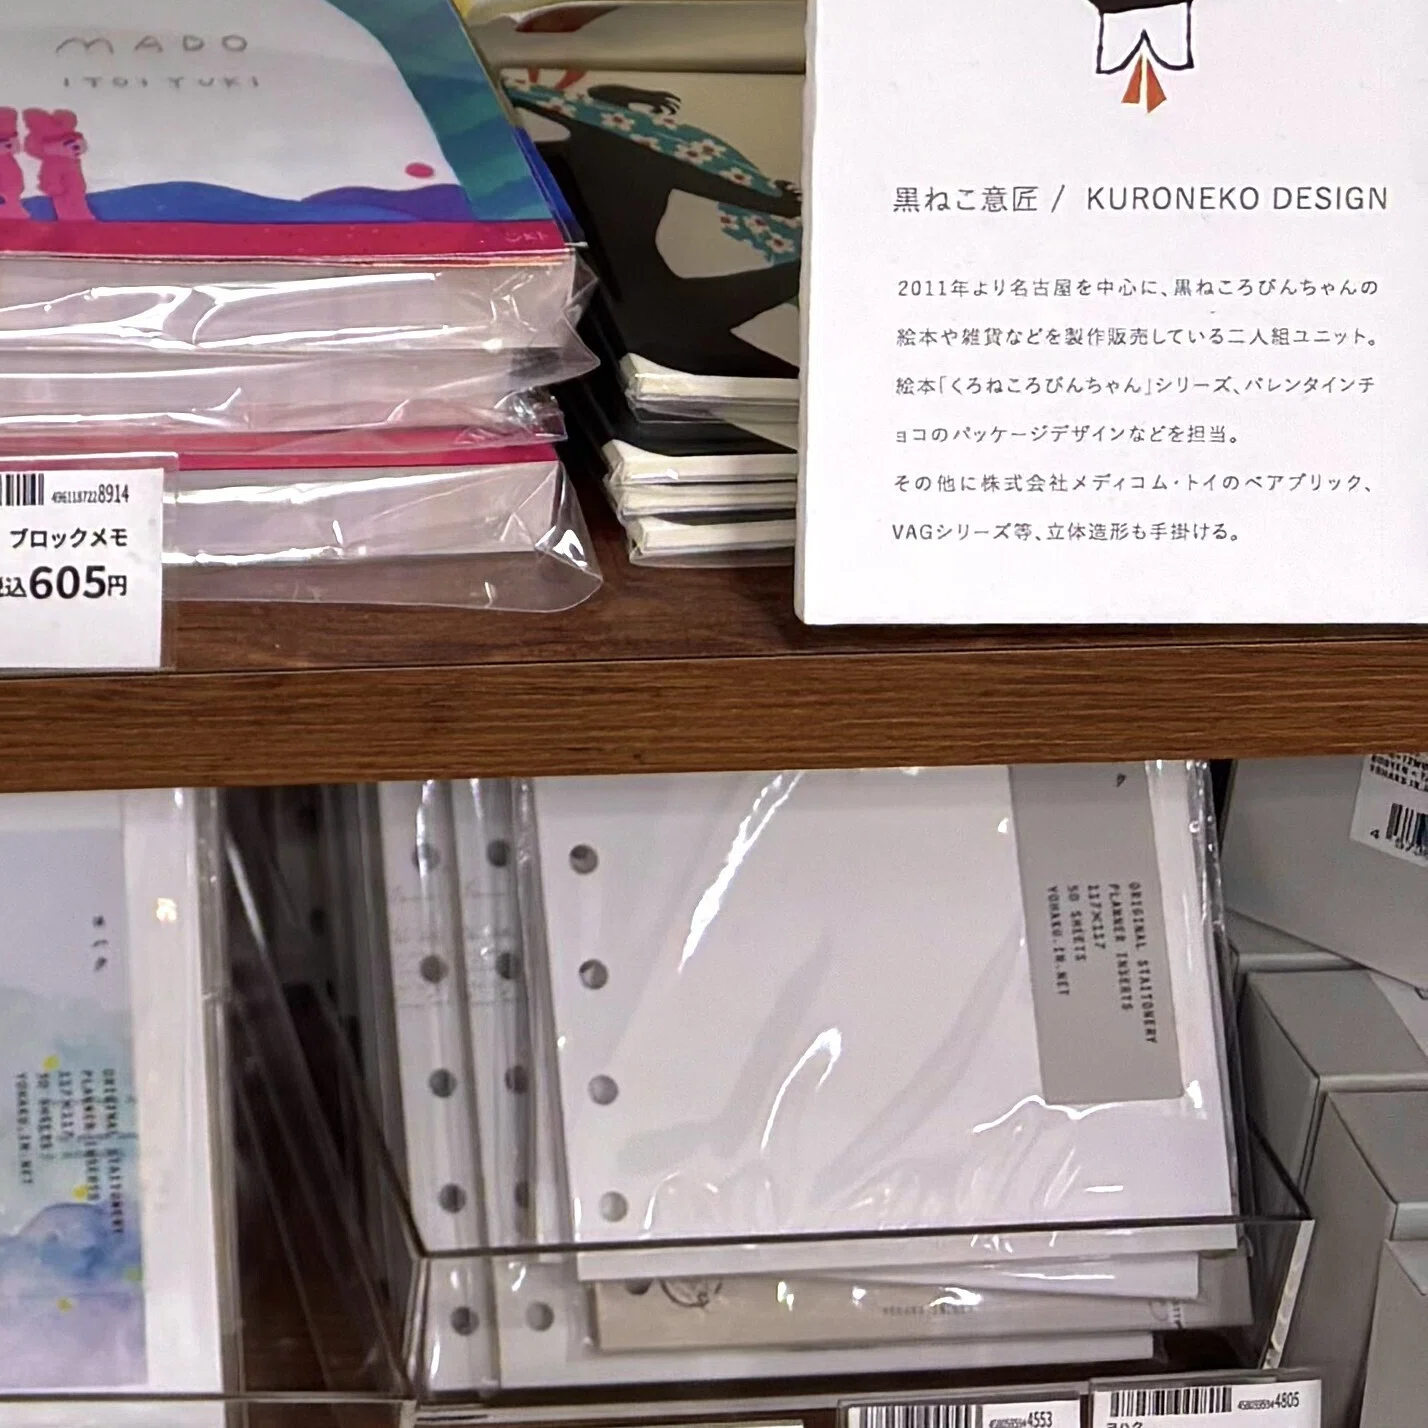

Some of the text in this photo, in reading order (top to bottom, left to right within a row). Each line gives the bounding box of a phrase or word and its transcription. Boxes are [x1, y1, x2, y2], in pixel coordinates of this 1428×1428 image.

[56, 35, 249, 55] MADO
[63, 76, 261, 88] ITOI YUKI
[892, 185, 1389, 214] 黒ねこ意匠 KURONEKO DESIGN
[897, 278, 1379, 299] 2011年より名古屋を中心に、黒ねころびんちゃんの
[896, 327, 1377, 347] 絵本や雑貨などを製作販売している二人組ユニット。
[10, 527, 128, 548] ブロックメモ
[892, 522, 1240, 543] VAGシリーズ等、立体造形も手掛ける。
[1129, 881, 1148, 950] ORIGINAL
[1071, 911, 1087, 962] SHEETS
[1109, 883, 1132, 1011] PLANNER INSERTS
